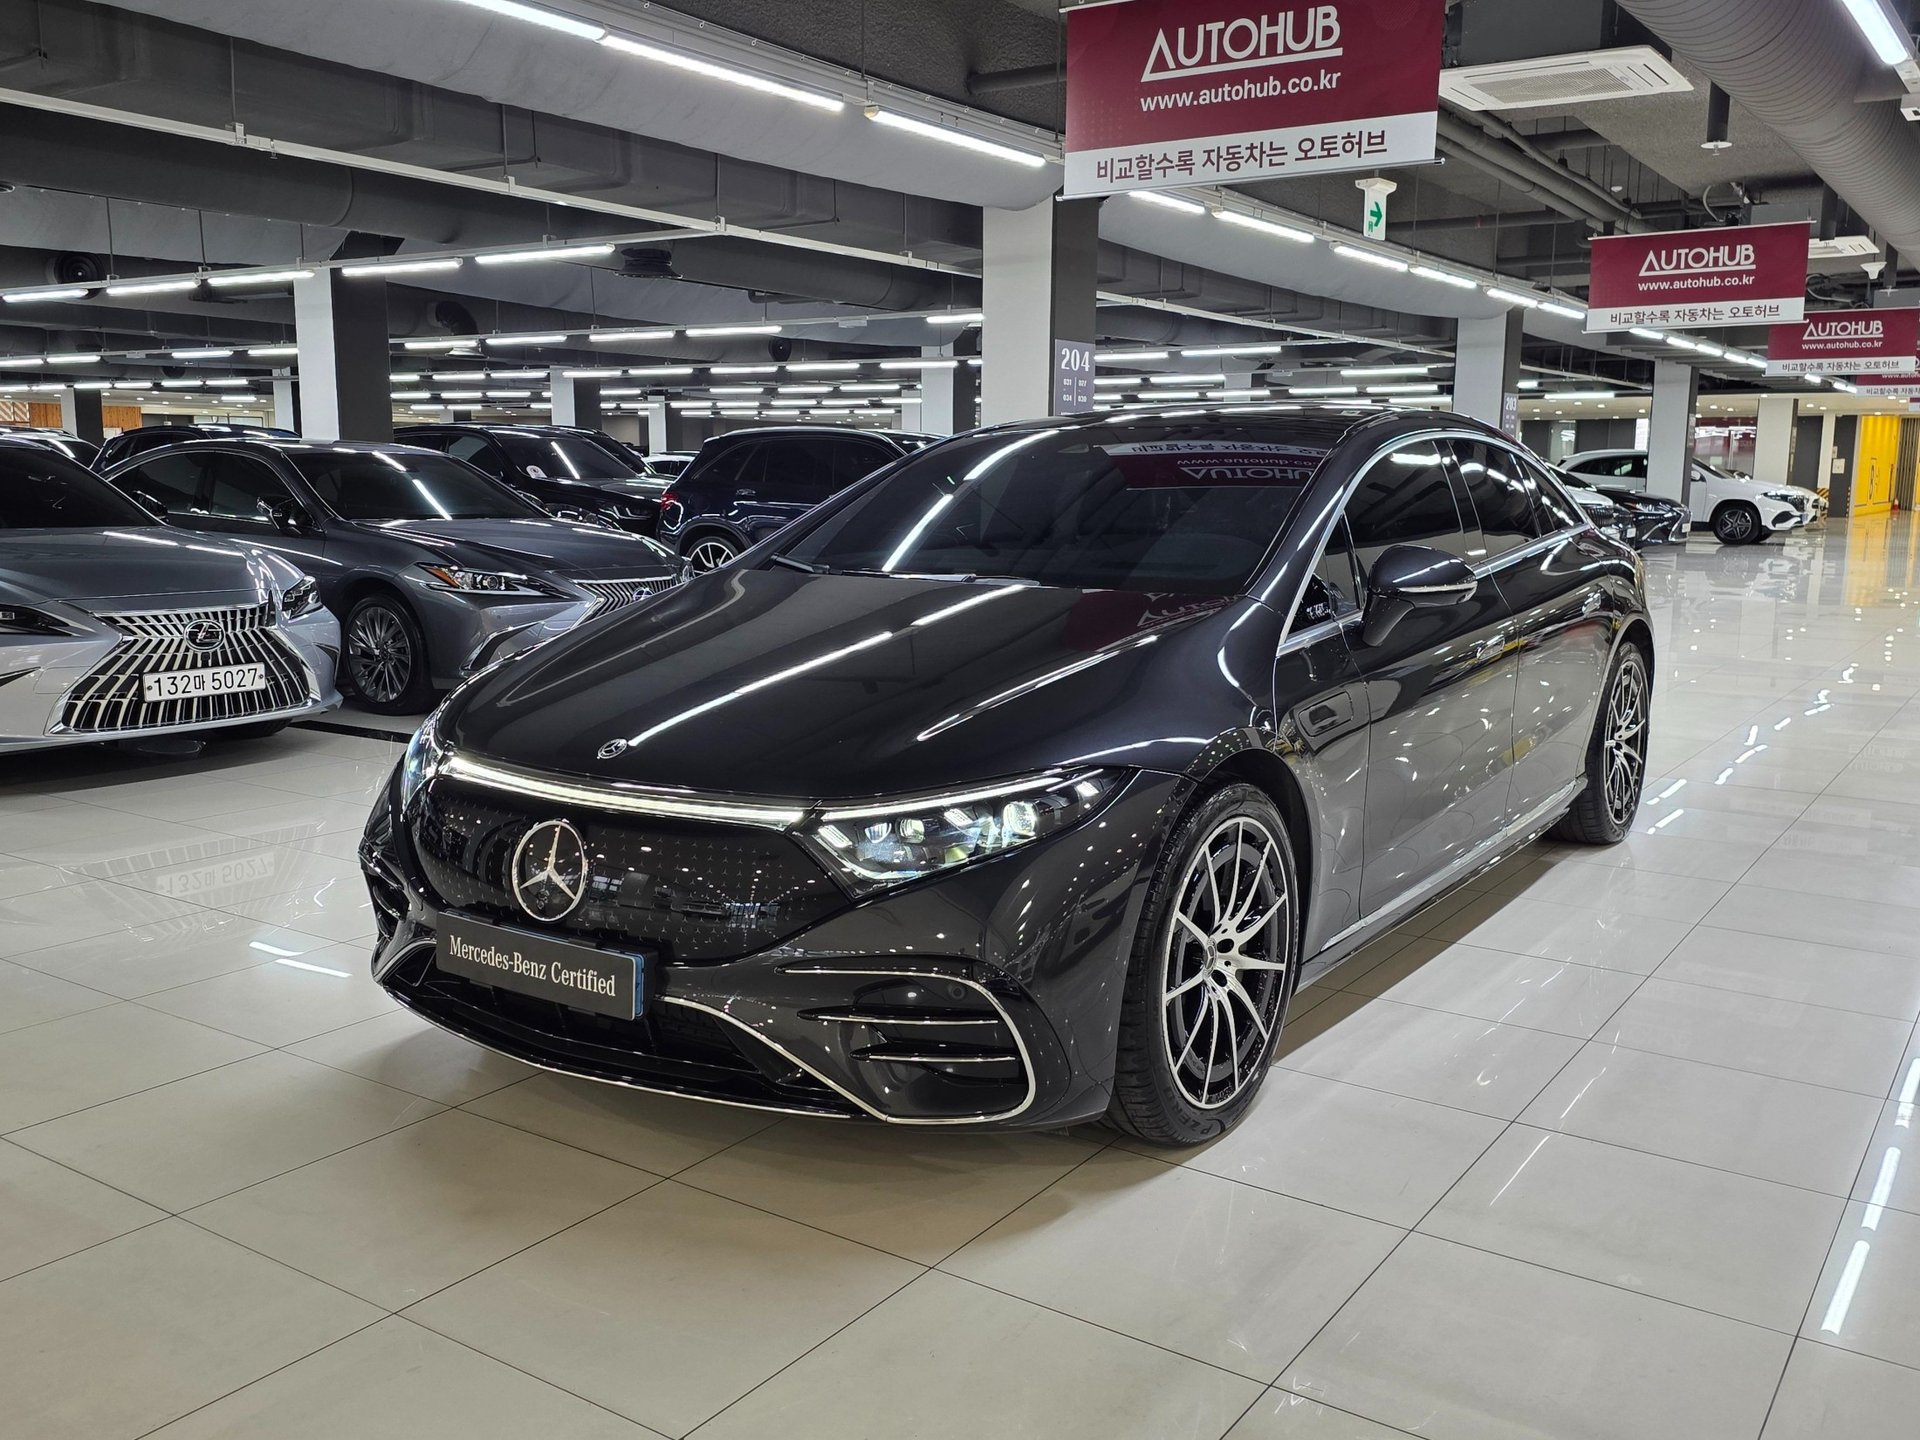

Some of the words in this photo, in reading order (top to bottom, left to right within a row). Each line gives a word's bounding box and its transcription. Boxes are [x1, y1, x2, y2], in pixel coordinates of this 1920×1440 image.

[1141, 5, 1343, 82] AUTOHUB
[1140, 69, 1341, 112] www.autohub.co.kr
[1096, 149, 1196, 183] 비교할수록
[1202, 141, 1288, 173] 자동차는
[1295, 130, 1387, 162] 오토허브
[1638, 244, 1756, 277] AUTOHUB
[1638, 274, 1755, 291] www.autohub.co.kr
[1610, 310, 1670, 325] 비교할수록
[1675, 308, 1724, 322] 자동차는
[1728, 304, 1781, 318] 오토허브
[1802, 320, 1884, 340] AUTOHUB
[1801, 340, 1883, 350] www.autohub.co.kr
[1061, 348, 1090, 371] 204
[1782, 361, 1823, 372] 비교할수록
[1826, 361, 1861, 371] 자동차는
[1864, 360, 1900, 370] 오토허브
[153, 674, 206, 696] 132마
[211, 667, 258, 690] 5027
[449, 934, 547, 980] Mercedes-Benz
[551, 961, 616, 997] Certified
